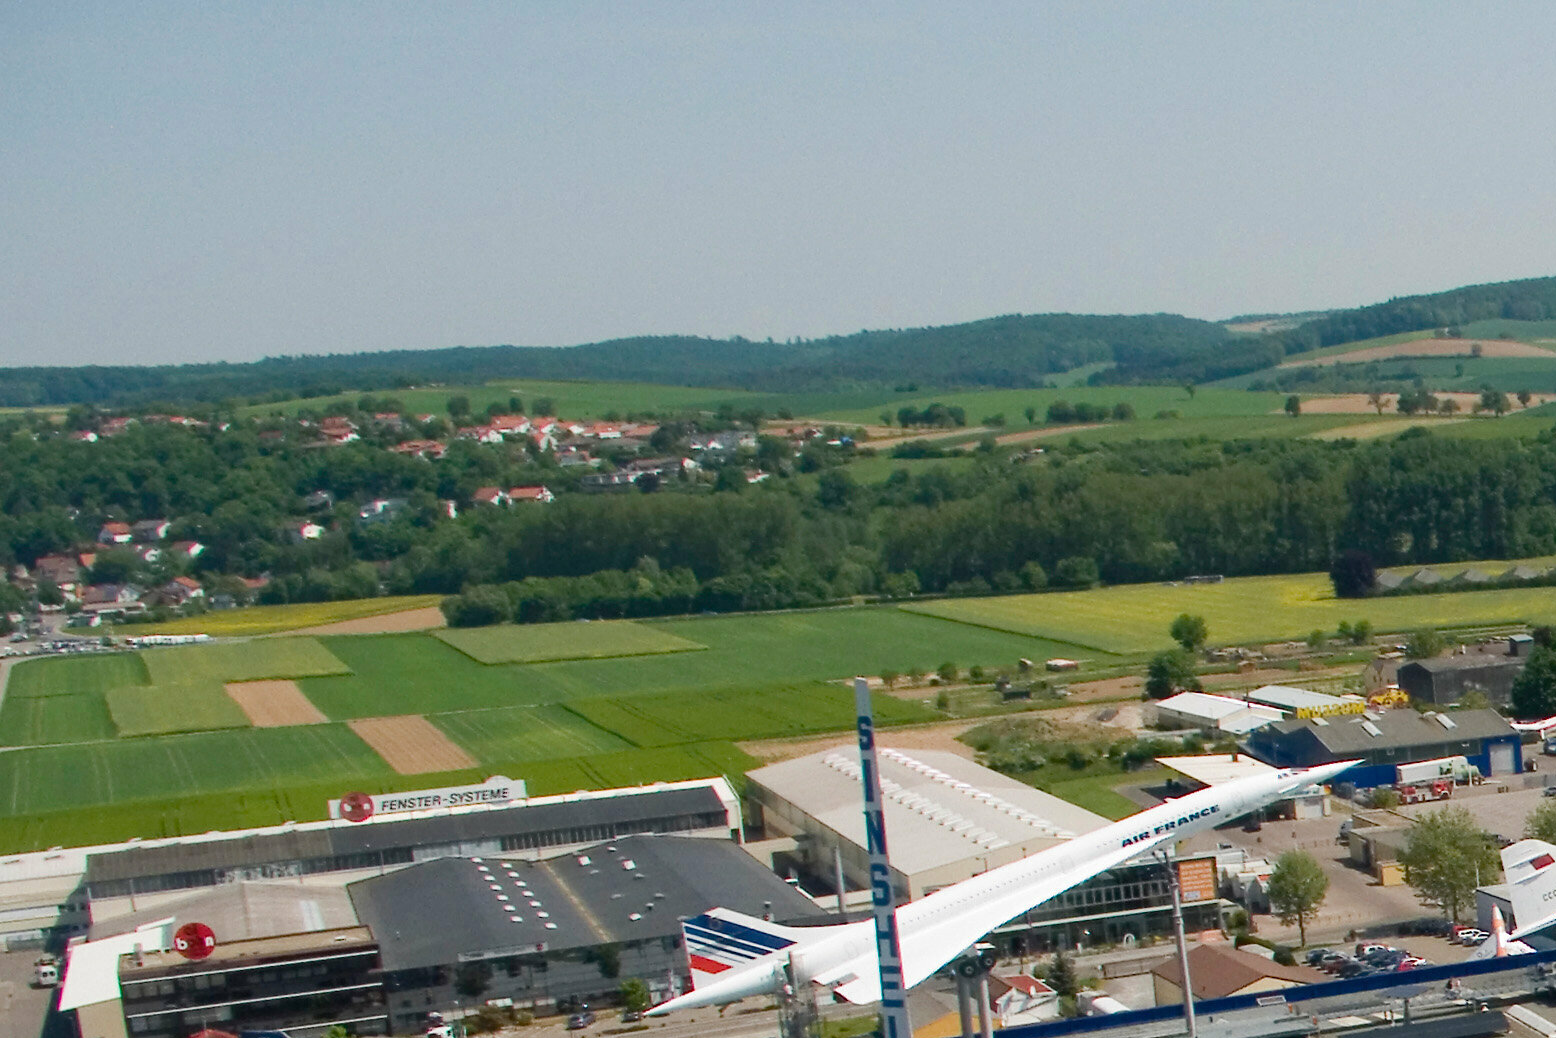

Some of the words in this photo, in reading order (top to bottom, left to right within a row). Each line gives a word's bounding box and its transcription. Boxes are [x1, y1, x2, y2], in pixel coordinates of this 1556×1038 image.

[381, 787, 510, 812] FENSTER-SYSTEME
[1121, 830, 1151, 848] AIR
[1153, 804, 1221, 835] FRANCE
